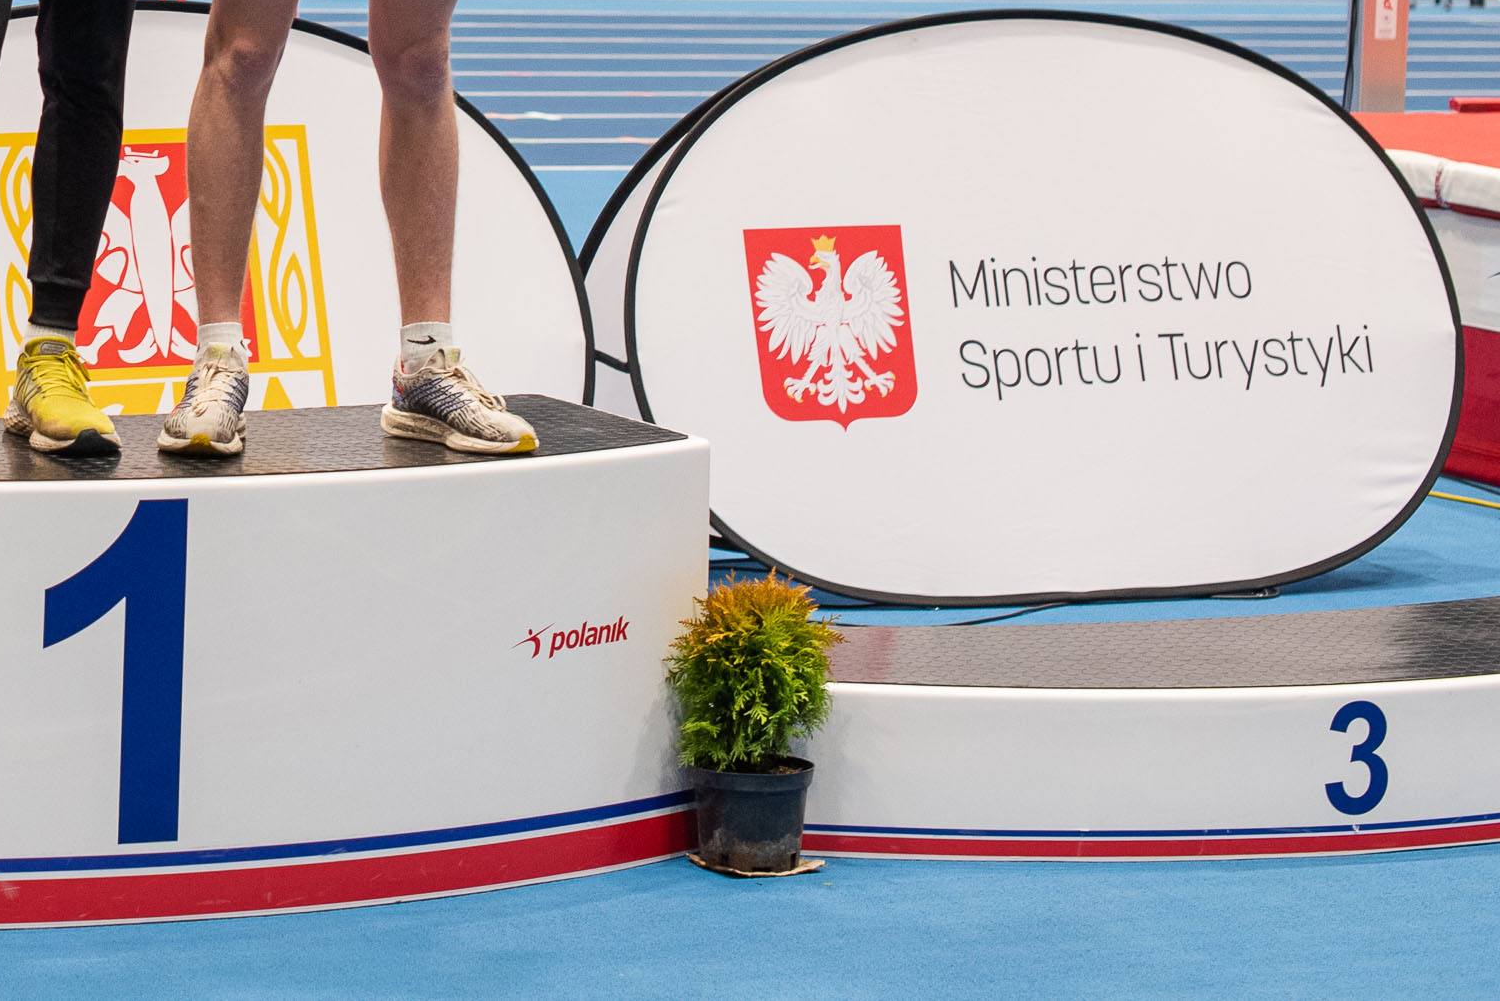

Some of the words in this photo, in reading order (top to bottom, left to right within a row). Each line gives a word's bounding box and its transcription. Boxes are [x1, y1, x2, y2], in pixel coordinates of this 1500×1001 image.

[949, 255, 1252, 309] Ministerstwo
[958, 336, 1121, 401] Sportu
[1135, 333, 1145, 382] i
[1158, 323, 1374, 391] Turystyki
[43, 498, 188, 845] 1
[548, 614, 630, 659] polanik
[1325, 700, 1388, 815] 3
